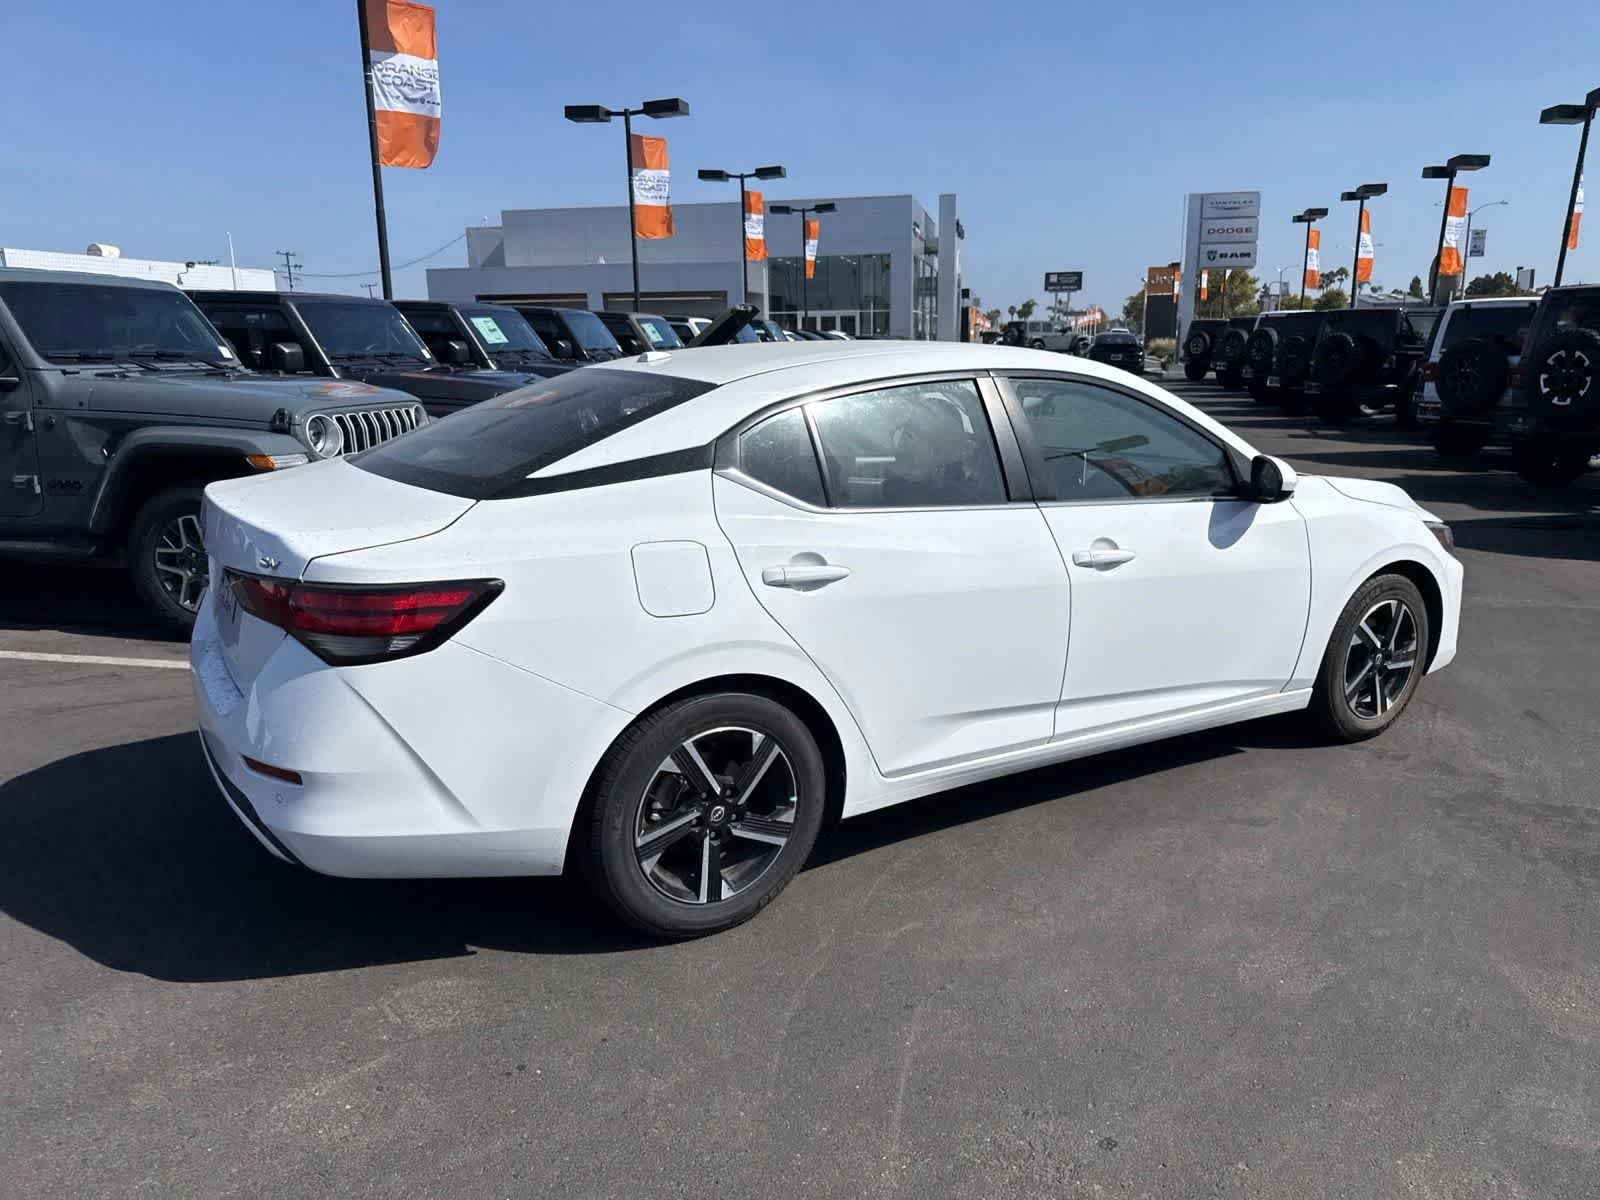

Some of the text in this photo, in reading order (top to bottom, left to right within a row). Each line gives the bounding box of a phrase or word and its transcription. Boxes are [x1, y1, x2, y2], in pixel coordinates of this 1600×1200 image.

[381, 74, 436, 92] COAST
[1207, 226, 1253, 235] DODGE
[1219, 251, 1251, 259] RAM
[260, 557, 281, 569] SV
